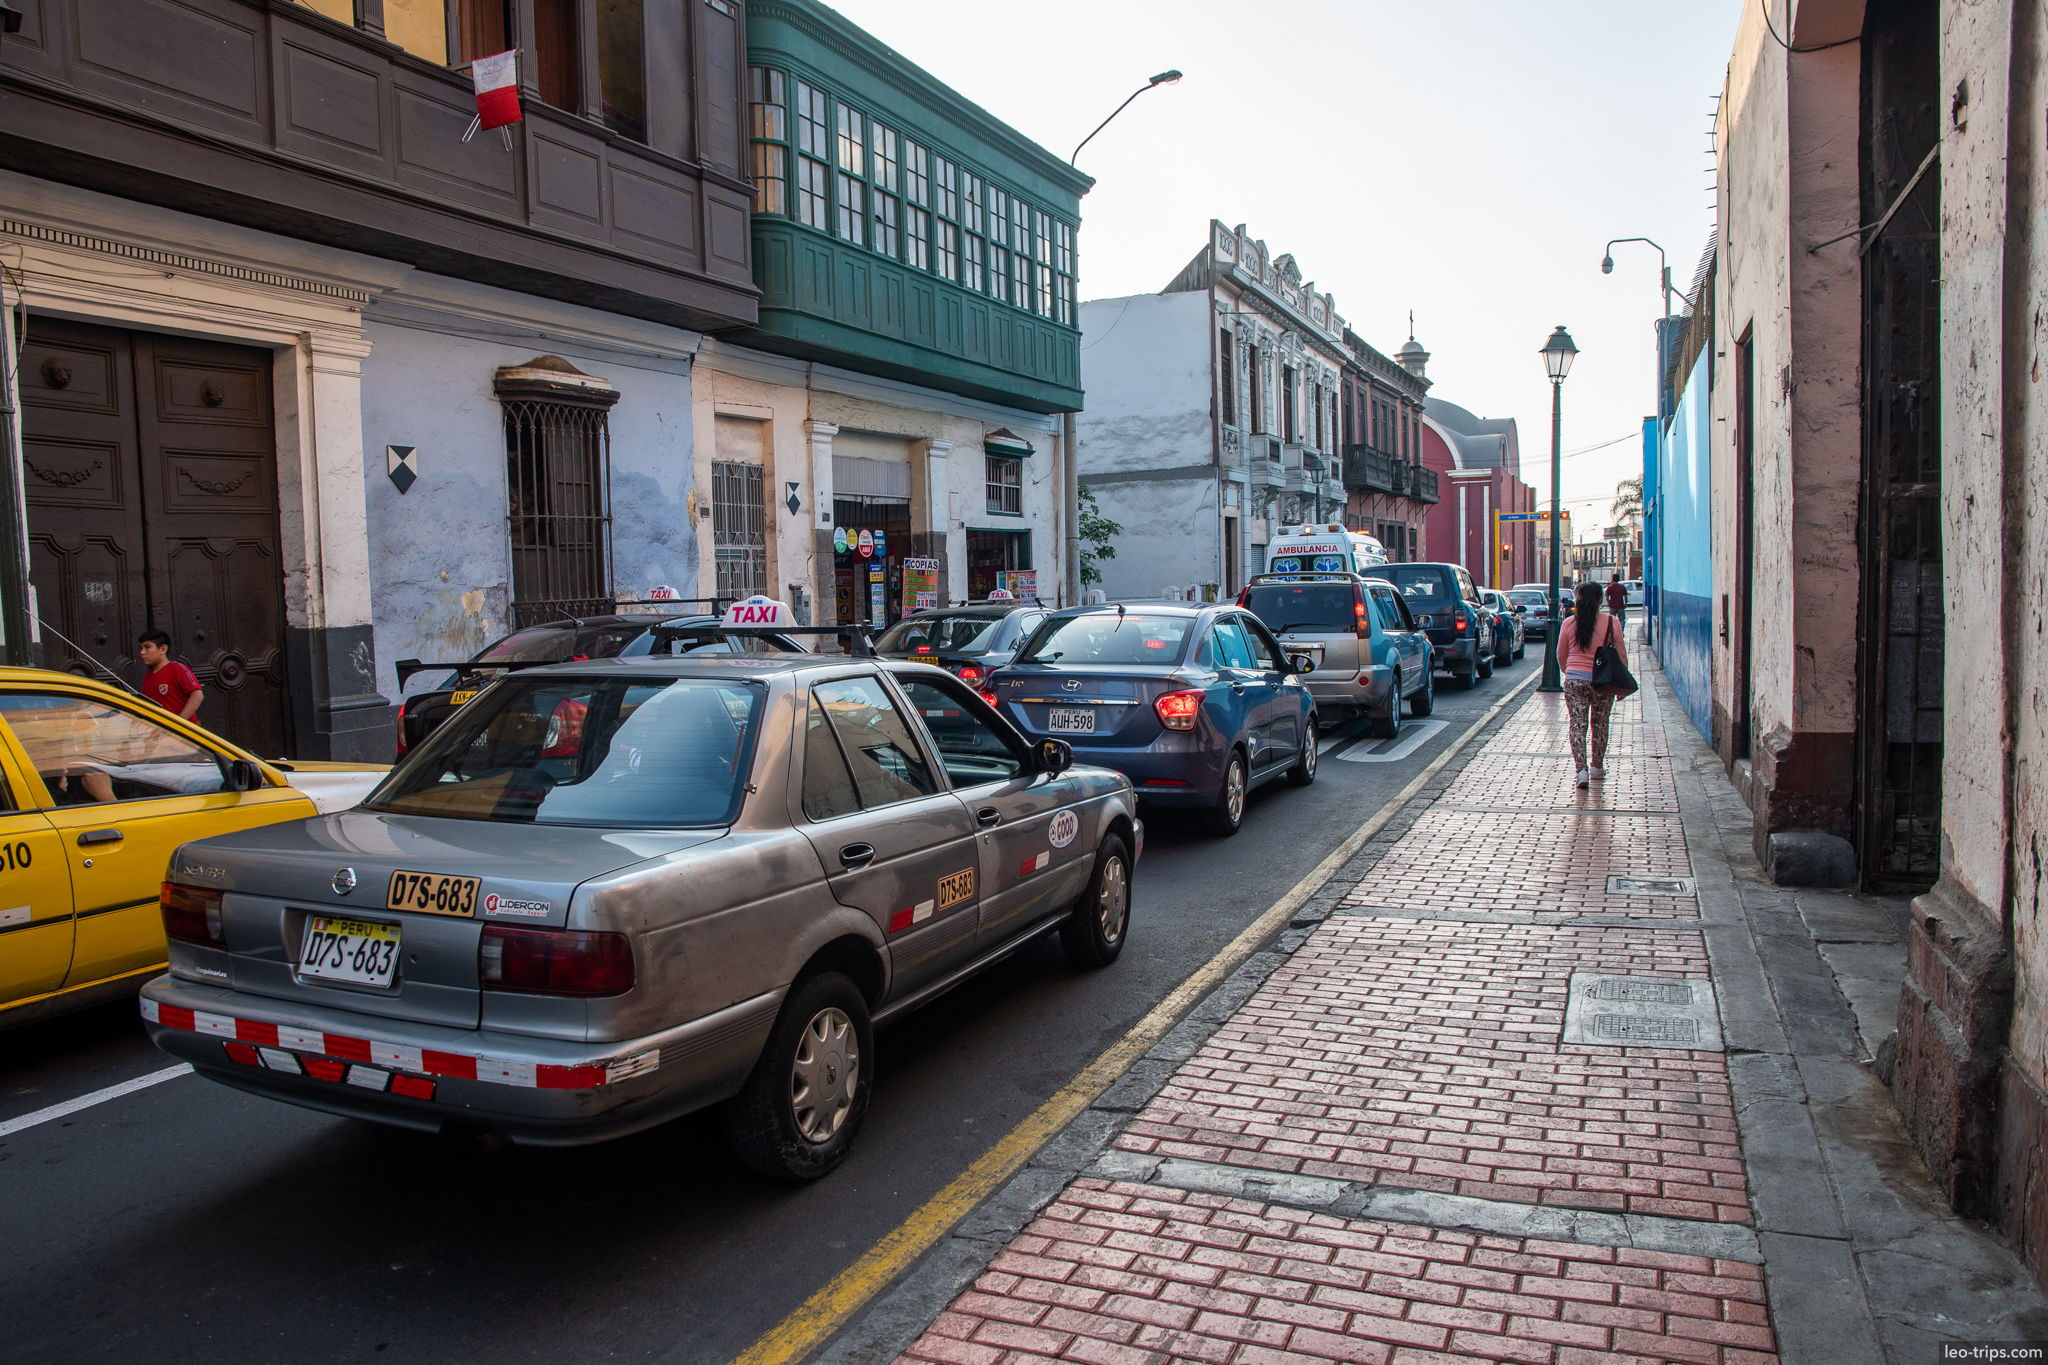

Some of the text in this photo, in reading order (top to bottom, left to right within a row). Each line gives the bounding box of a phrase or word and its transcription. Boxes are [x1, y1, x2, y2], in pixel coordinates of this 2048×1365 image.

[1277, 545, 1338, 554] AMBULANCIA
[910, 561, 938, 569] COPIAS
[650, 590, 671, 599] TAXI
[732, 606, 777, 623] TAXI
[1051, 715, 1093, 729] AUH-598
[183, 865, 225, 879] SENTRA
[391, 873, 475, 913] D7S-683
[941, 872, 973, 905] D7S-683
[500, 900, 549, 911] LIDERCON
[341, 921, 373, 936] PERU
[304, 931, 396, 975] D7S-683
[195, 966, 227, 978] Maquinarias
